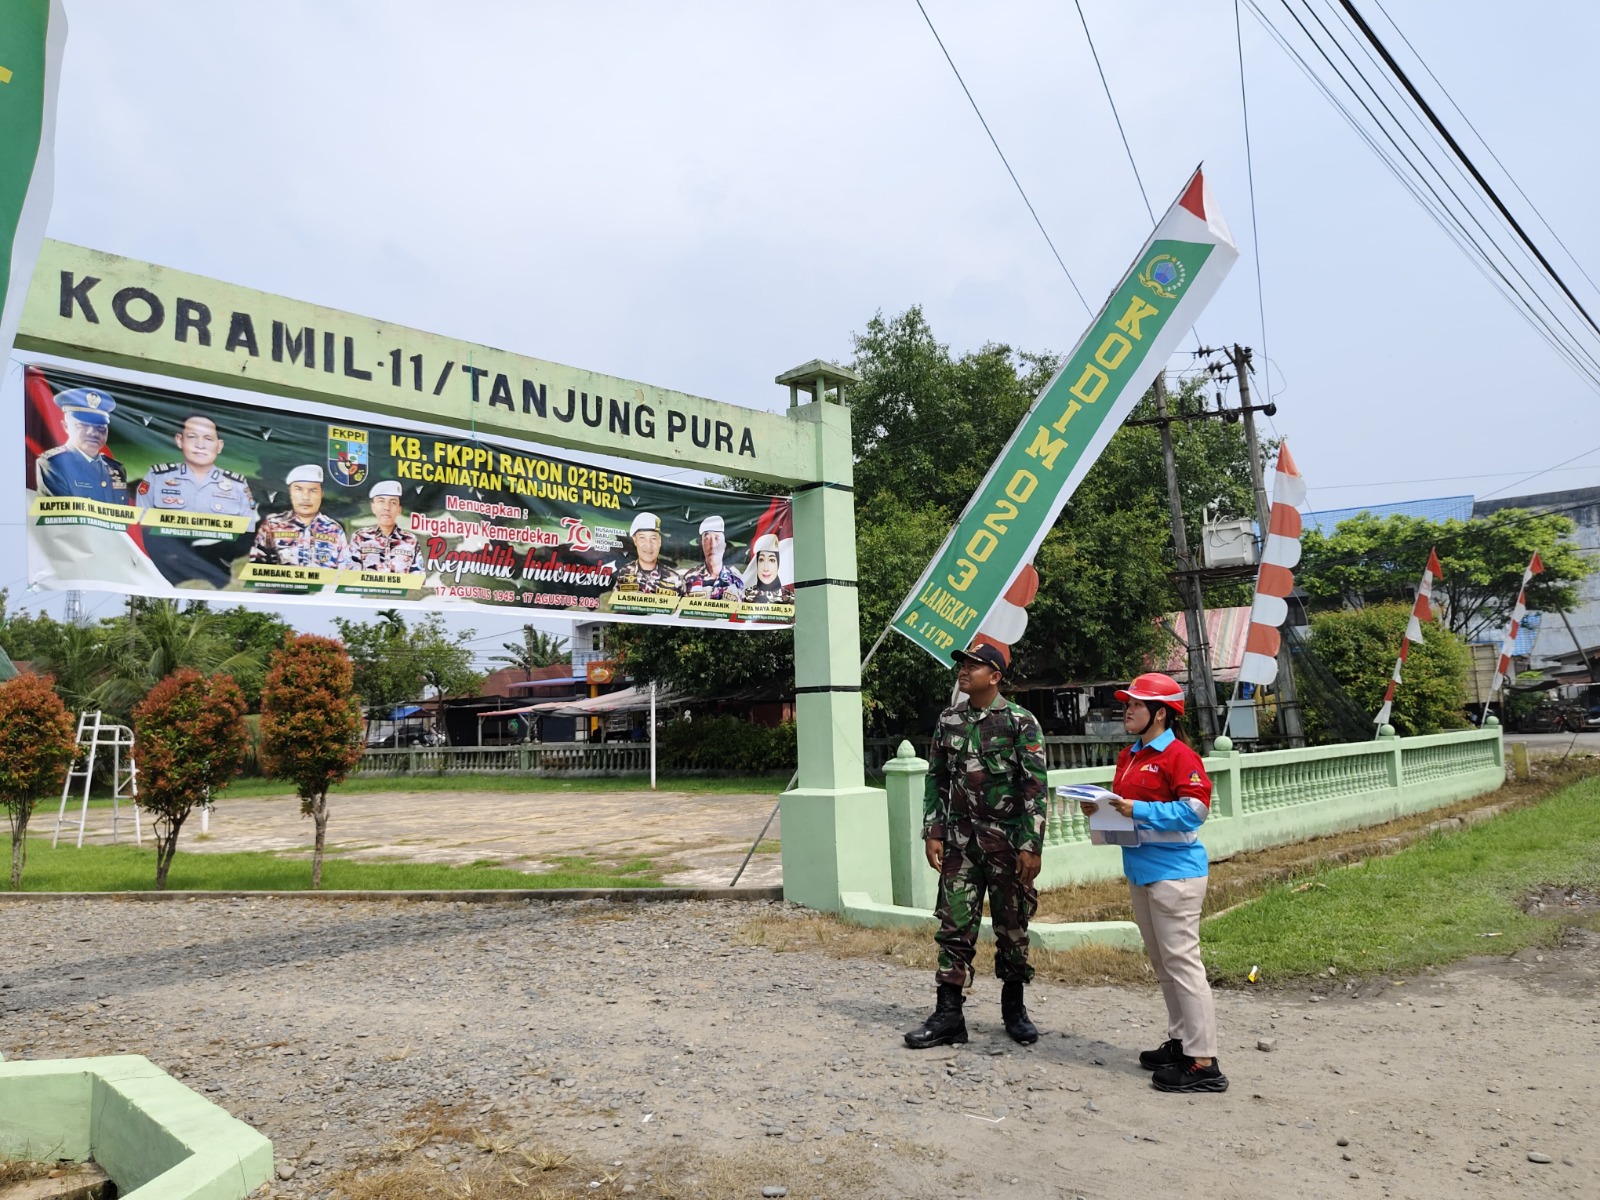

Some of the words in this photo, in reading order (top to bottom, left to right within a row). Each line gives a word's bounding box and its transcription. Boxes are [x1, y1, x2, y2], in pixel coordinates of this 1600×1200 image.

[1026, 296, 1158, 471] KODIM
[332, 428, 366, 442] FKPPI
[667, 409, 756, 459] PURA
[390, 434, 428, 461] KB.
[434, 442, 493, 471] FKPPI
[500, 453, 563, 482] RAYON
[567, 465, 633, 496] 0215-05
[397, 459, 502, 492] KECAMATAN
[507, 475, 579, 503] TANJUNG
[583, 490, 621, 510] PURA
[40, 502, 71, 511] KAPTEN
[97, 506, 135, 519] BATUBARA
[223, 520, 233, 528] SH
[446, 495, 521, 519] Menucapkan
[411, 512, 479, 538] Dirgahayu
[481, 521, 559, 546] Kemerdekan
[560, 517, 592, 552] 79
[947, 468, 1039, 592] 0203
[307, 571, 320, 579] MH
[361, 574, 386, 582] AZHARI
[387, 575, 401, 583] HSB
[427, 536, 515, 584] Republik
[522, 546, 614, 587] Indonesia
[435, 586, 446, 597] 17
[450, 586, 491, 599] AGUSTUS
[493, 590, 515, 602] 1945
[522, 593, 533, 603] 17
[534, 593, 577, 607] AGUSTUS
[579, 596, 599, 608] 2024
[703, 601, 729, 609] ARBANIK
[919, 581, 978, 631] LANGKAT
[904, 611, 917, 630] R.
[919, 621, 954, 650] 11/TP
